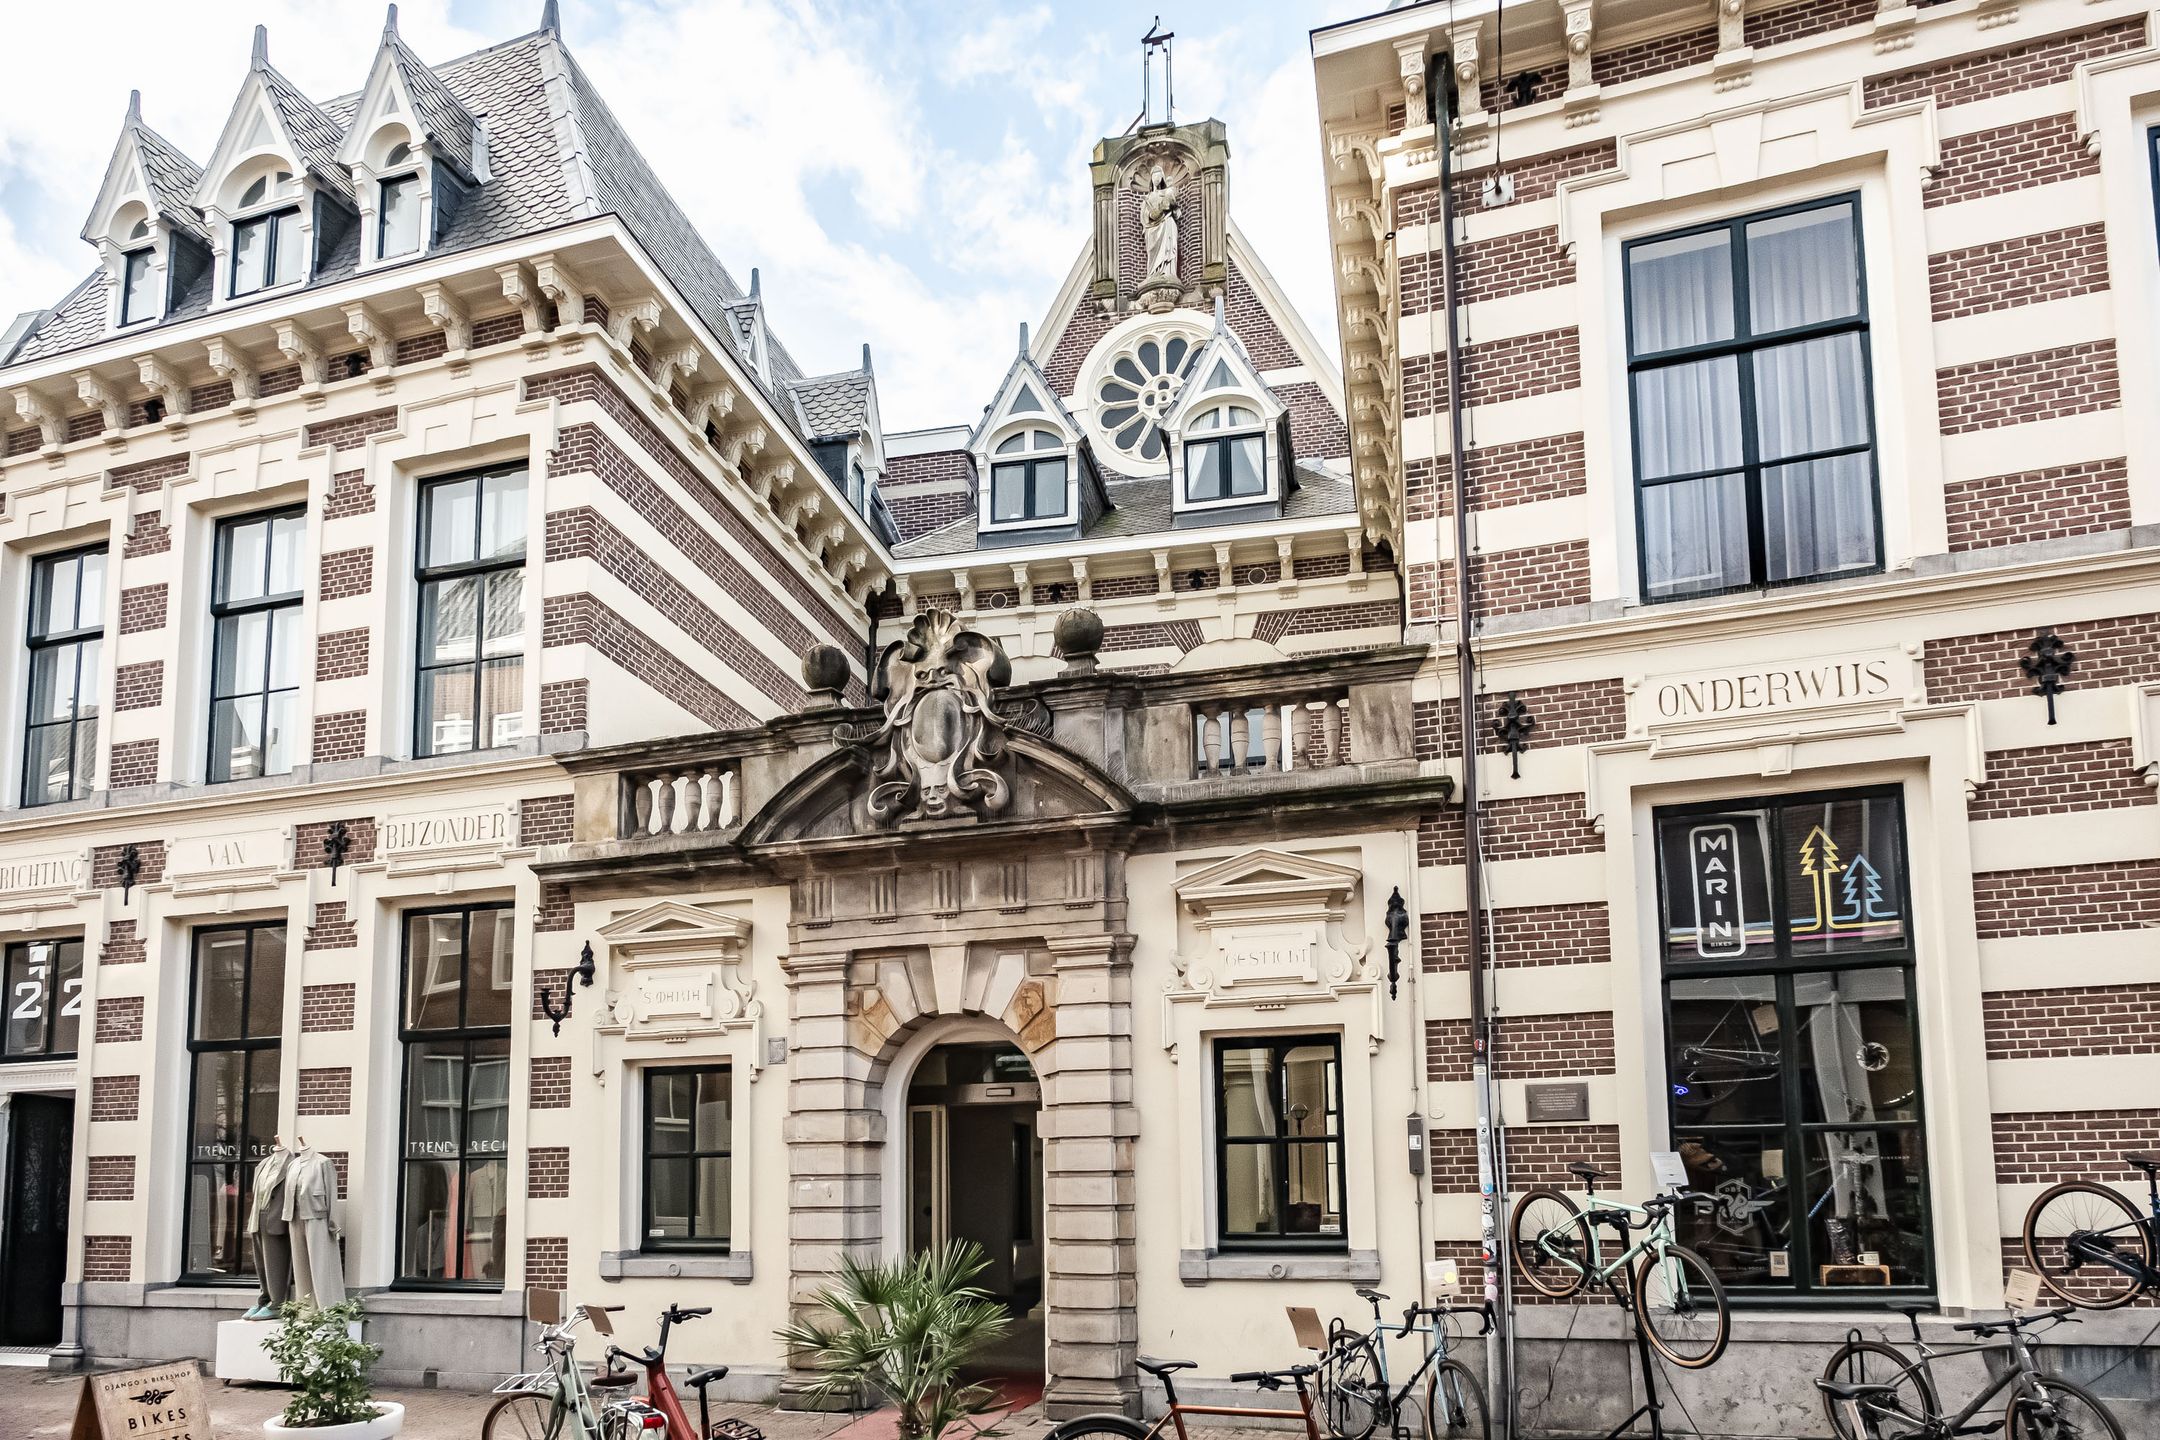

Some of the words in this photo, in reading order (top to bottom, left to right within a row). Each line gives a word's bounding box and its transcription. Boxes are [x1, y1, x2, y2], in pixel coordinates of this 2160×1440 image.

[1657, 660, 1891, 717] ONDERWIJS
[206, 840, 247, 866] VAN
[384, 811, 507, 850] BIJZONDER
[1700, 834, 1732, 938] MARIN
[104, 1379, 147, 1391] DJANGO'S
[151, 1371, 190, 1383] BIKESHOP
[128, 1408, 186, 1429] BIKES
